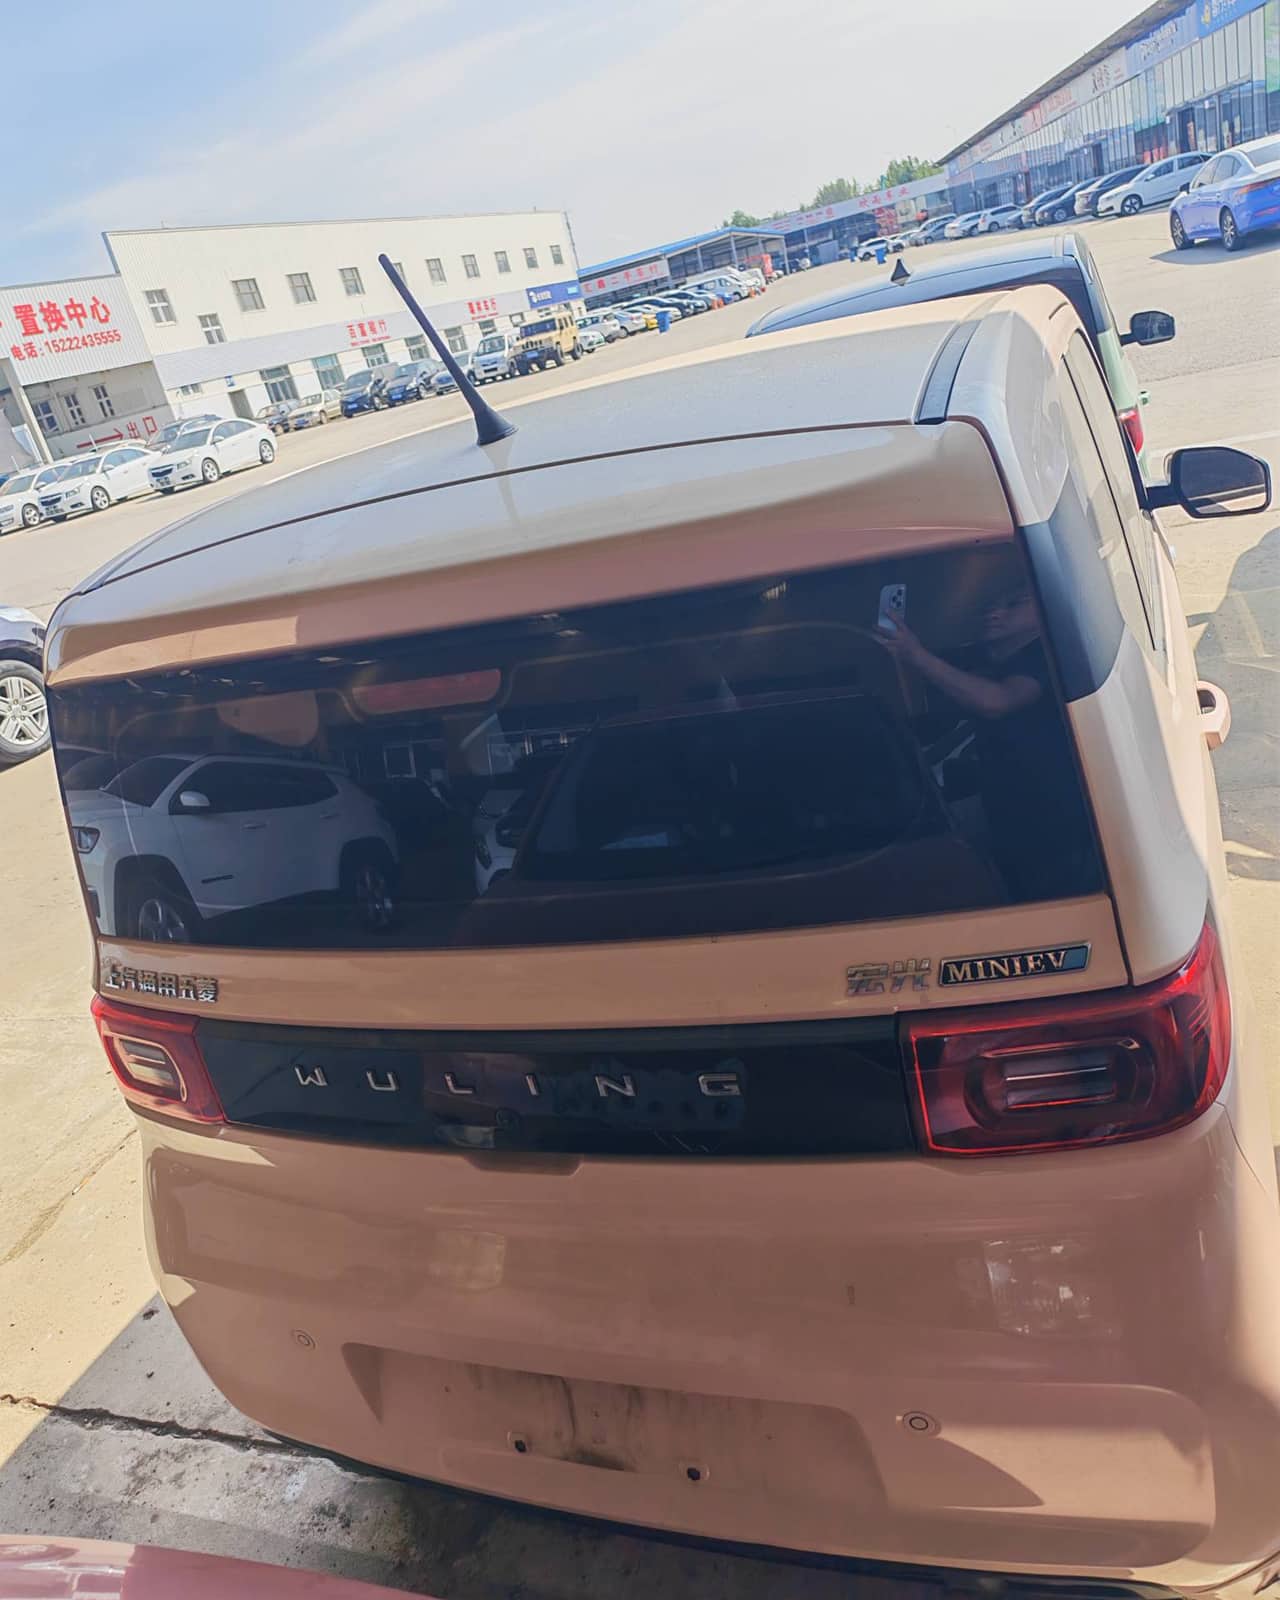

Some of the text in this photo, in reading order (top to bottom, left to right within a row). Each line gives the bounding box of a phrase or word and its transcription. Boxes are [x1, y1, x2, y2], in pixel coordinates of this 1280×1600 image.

[13, 296, 110, 336] 置换中心
[127, 416, 157, 440] 出口
[104, 963, 218, 1003] 上汽通用五菱
[846, 957, 931, 995] 宏光
[945, 950, 1067, 983] MINIEV
[294, 1065, 741, 1098] WULING
